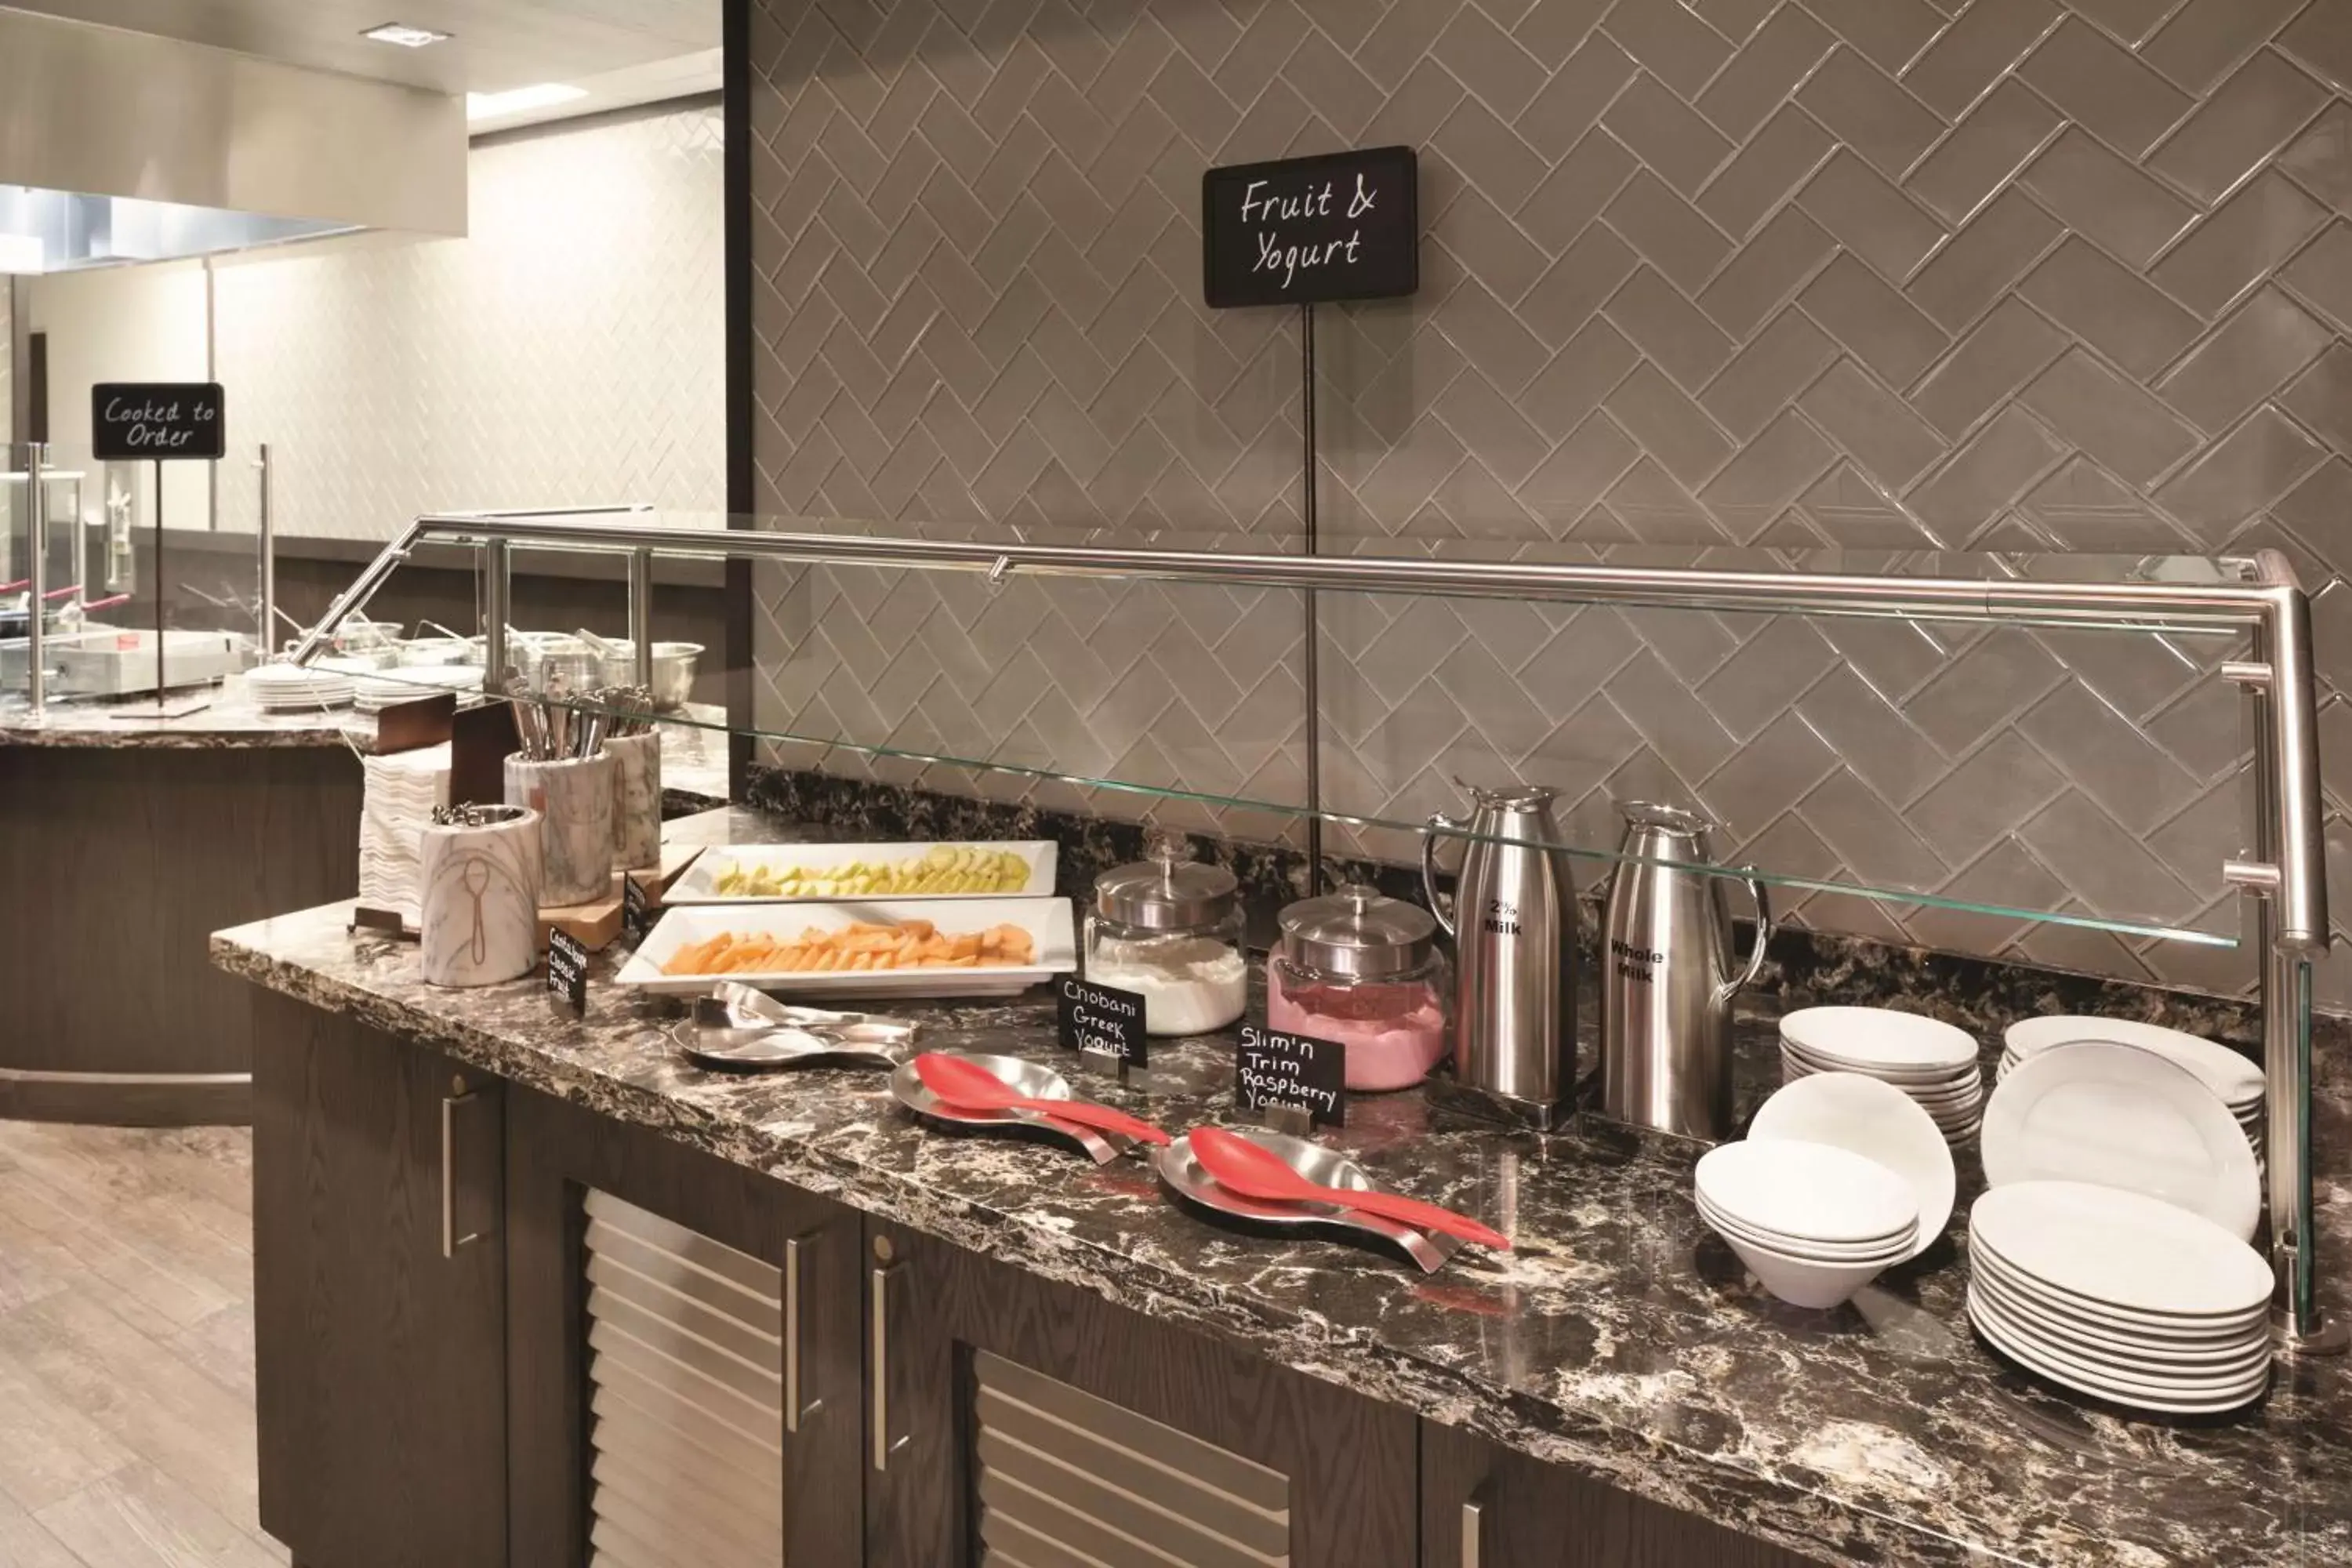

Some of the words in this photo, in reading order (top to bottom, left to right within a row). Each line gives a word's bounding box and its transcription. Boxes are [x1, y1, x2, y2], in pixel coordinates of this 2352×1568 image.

[1241, 180, 1333, 223] Fruit
[1347, 172, 1377, 219] &
[1252, 230, 1361, 289] Yogurt
[104, 397, 180, 423] Cooked
[193, 401, 215, 422] to
[125, 423, 194, 447] Order
[1490, 898, 1518, 916] 2%
[1484, 918, 1522, 936] Milk
[1611, 938, 1664, 964] Whole
[1617, 962, 1653, 983] Milk
[1064, 980, 1136, 1017] Chobani
[1241, 1026, 1314, 1060] Slim'n
[1246, 1053, 1300, 1076] Trim
[1240, 1067, 1337, 1112] Raspberry
